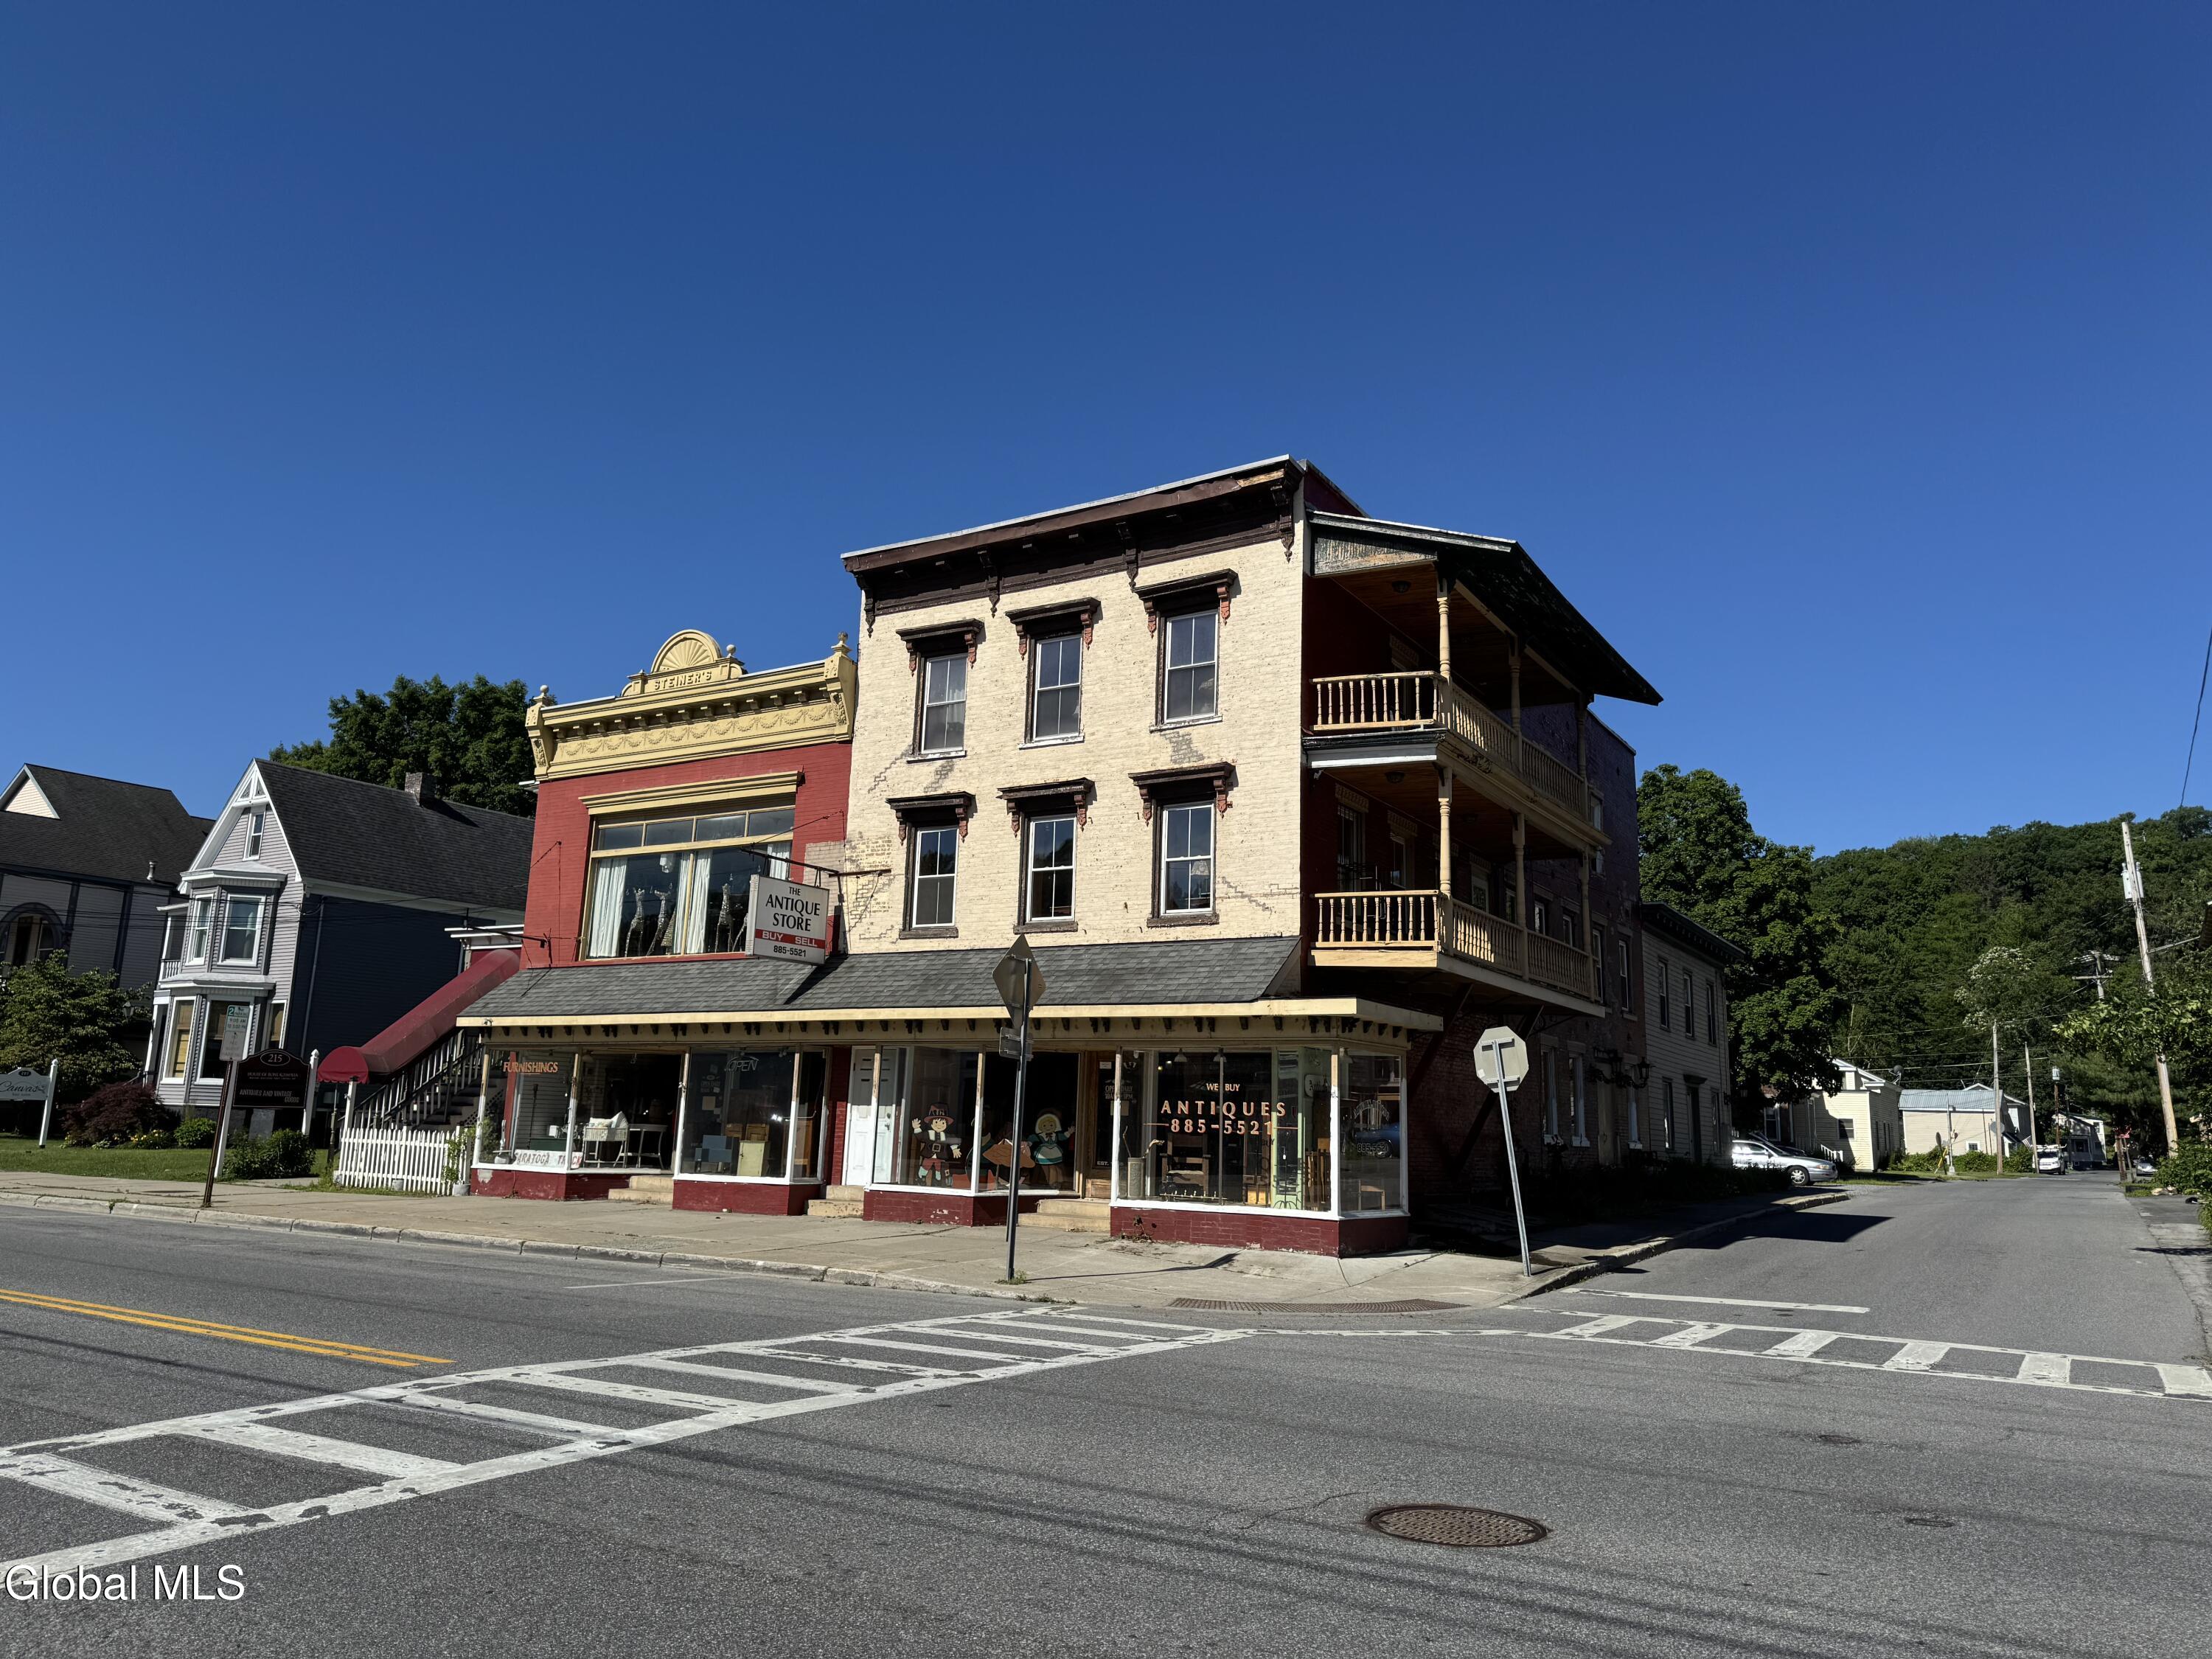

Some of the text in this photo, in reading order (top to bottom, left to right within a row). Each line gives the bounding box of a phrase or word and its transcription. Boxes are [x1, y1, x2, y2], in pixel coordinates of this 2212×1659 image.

[655, 672, 712, 690] STEINER'S
[789, 886, 801, 896] THE
[765, 894, 820, 917] ANTIQUE
[773, 913, 811, 931] STORE
[762, 931, 818, 947] BUY SELL
[773, 945, 806, 957] 885-5521
[229, 1007, 234, 1015] 2
[268, 1054, 282, 1062] 215
[503, 1062, 558, 1073] FURNISHINGS
[728, 1060, 758, 1071] OPEN
[240, 1088, 262, 1096] ANTIQUES
[1225, 1083, 1240, 1091] BUY
[1161, 1100, 1286, 1119] ANTIQUES
[1171, 1119, 1273, 1135] 885-5521
[557, 1154, 582, 1166] TRCK
